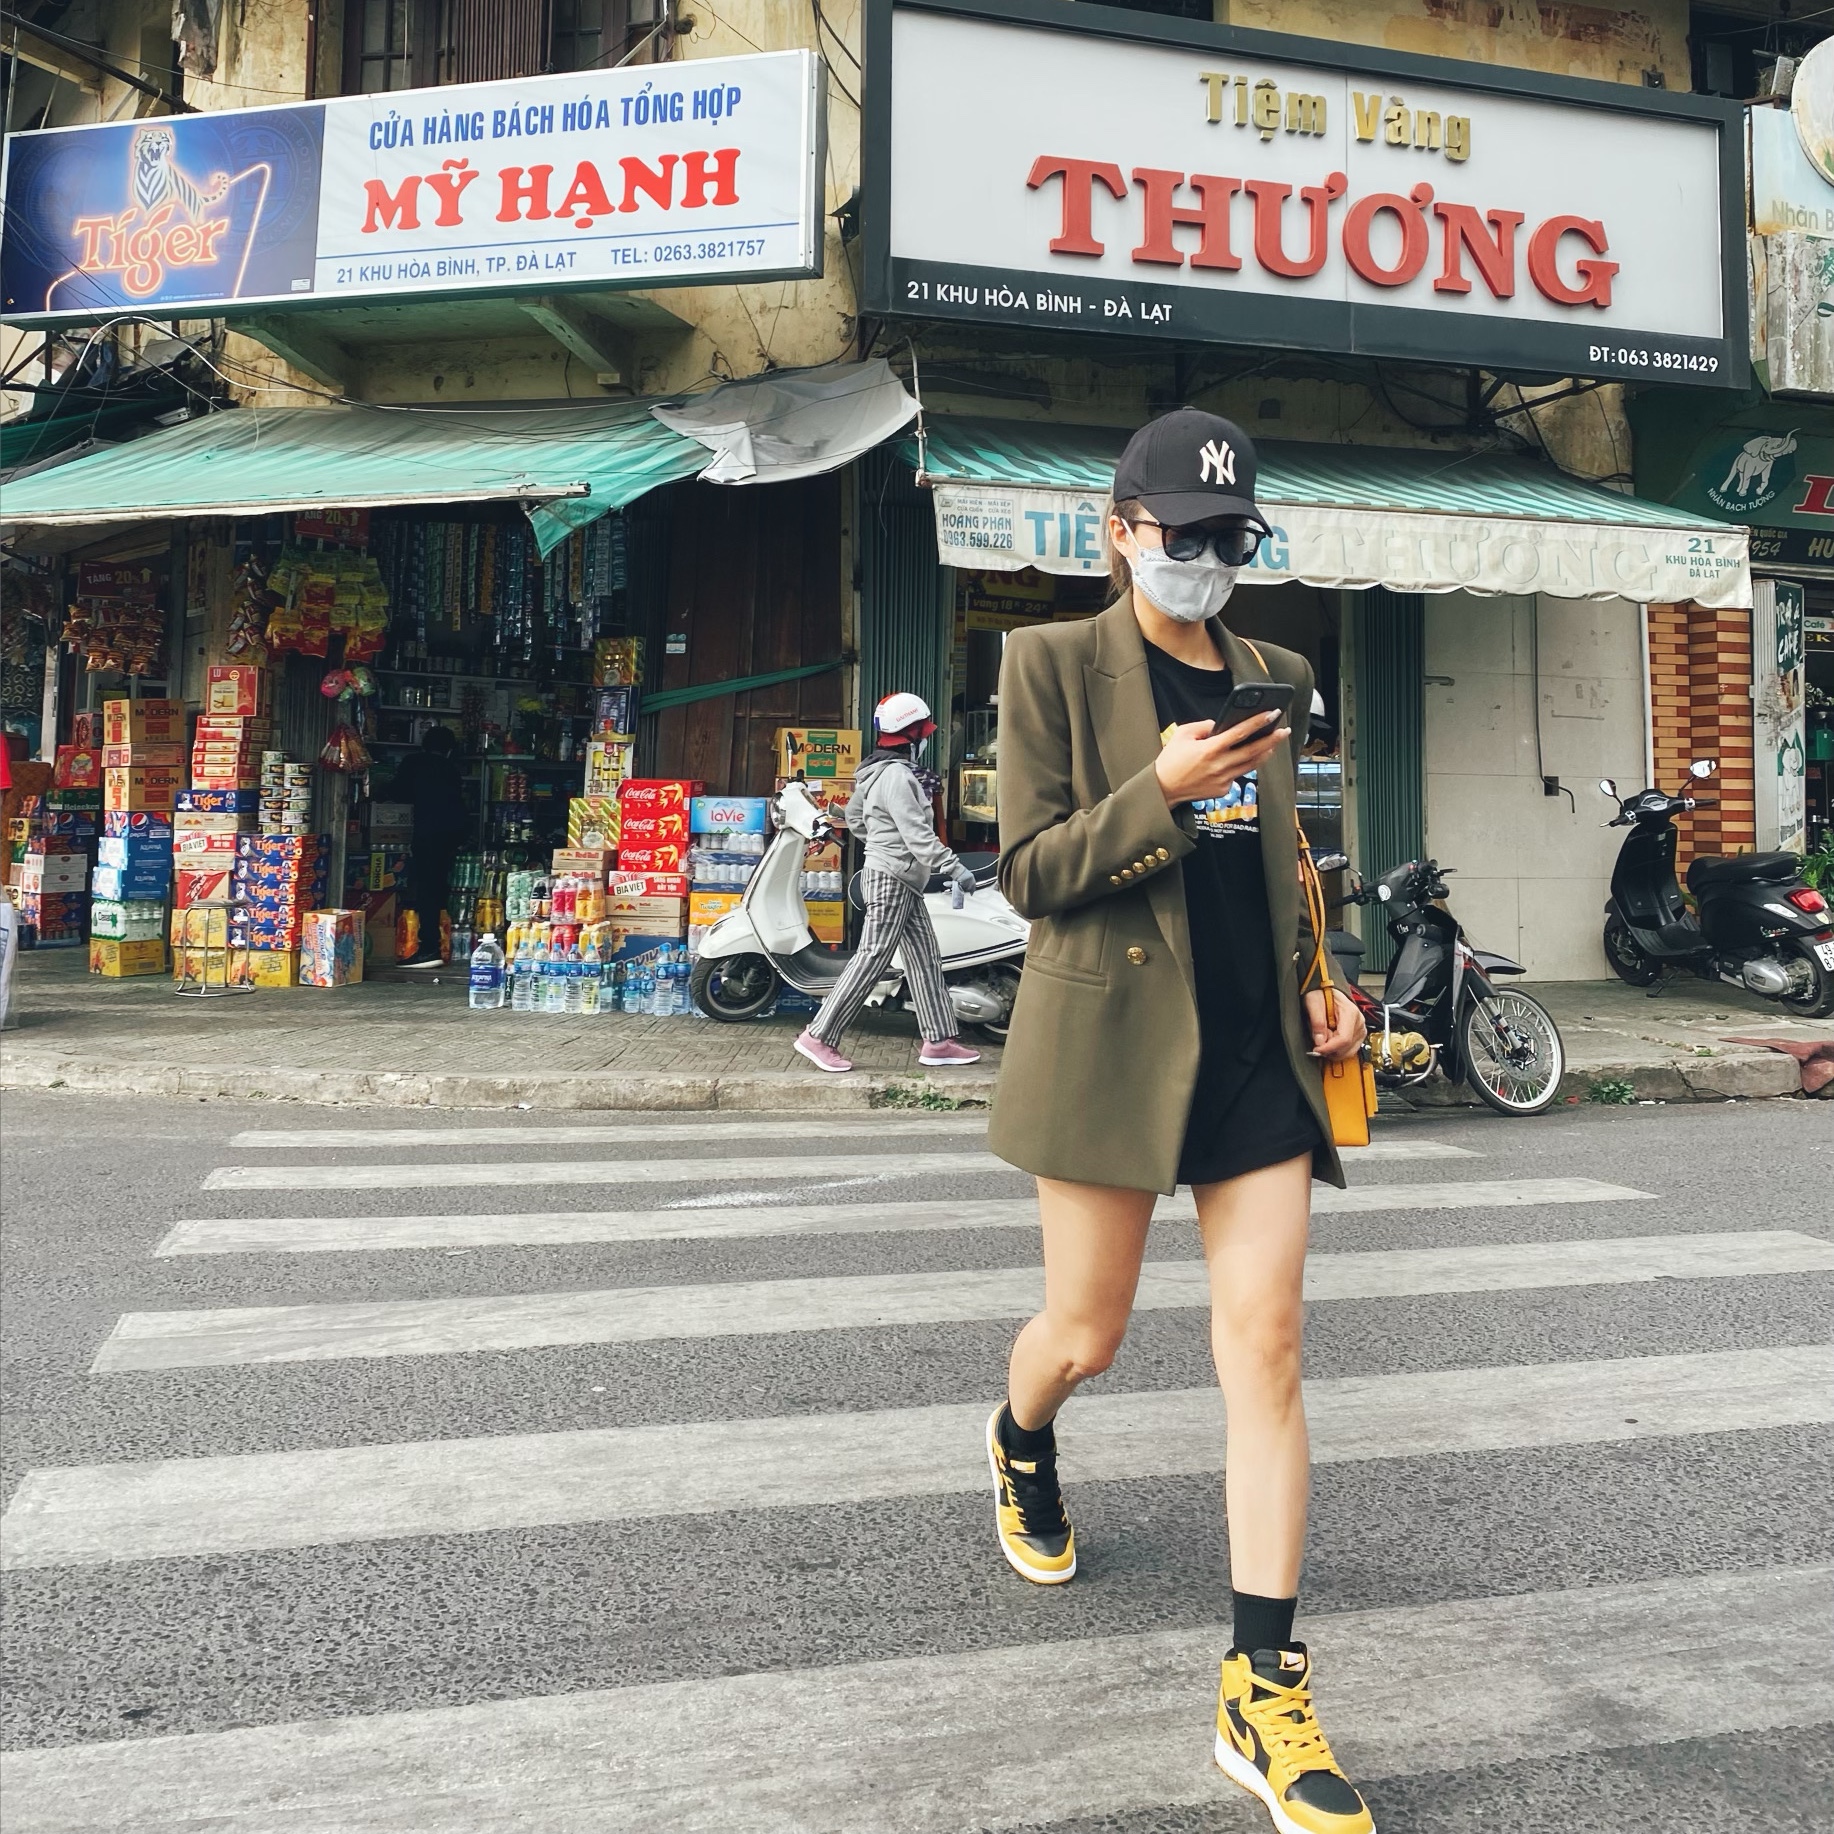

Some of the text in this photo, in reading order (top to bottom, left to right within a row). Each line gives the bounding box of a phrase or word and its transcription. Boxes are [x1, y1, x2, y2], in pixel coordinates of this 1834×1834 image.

[368, 82, 742, 150] CỬA HÀNG BÁCH HÓA TỔNG HỢP
[1199, 71, 1471, 162] Tiệm Vàng
[361, 158, 479, 233] MỸ
[495, 148, 741, 229] HẠNH
[1772, 200, 1819, 230] Nhãn
[1025, 155, 1620, 308] THƯƠNG
[73, 204, 229, 296] Tiger
[337, 239, 766, 283] 21 KHU HÒA BÌNH, TP. ĐÀ LẠT TEL: 0263.3821757
[907, 280, 929, 300] 21
[936, 284, 978, 305] KHU
[984, 284, 1030, 310] HÒA
[1036, 289, 1082, 313] BÌNH
[1104, 296, 1132, 318] ĐÀ
[1141, 302, 1173, 325] LẠT
[1652, 351, 1719, 373] 3821429
[1707, 487, 1726, 507] NHÃN
[1725, 502, 1747, 512] BẠCH
[1749, 490, 1776, 510] TƯỢNG
[943, 529, 1012, 549] 0963.599.226
[1024, 502, 1101, 569] TIỆ
[1688, 537, 1715, 554] 21
[1665, 555, 1740, 568] KHU HÒA BÌNH
[1689, 566, 1720, 580] ĐÀ LẠT
[1804, 619, 1825, 629] Café
[192, 792, 224, 811] Tiger
[711, 808, 745, 822] laVie
[254, 837, 284, 855] Tiger
[251, 860, 281, 878] Tiger
[250, 882, 277, 901] Tiger
[616, 885, 629, 895] BIA
[250, 905, 276, 923] Tiger
